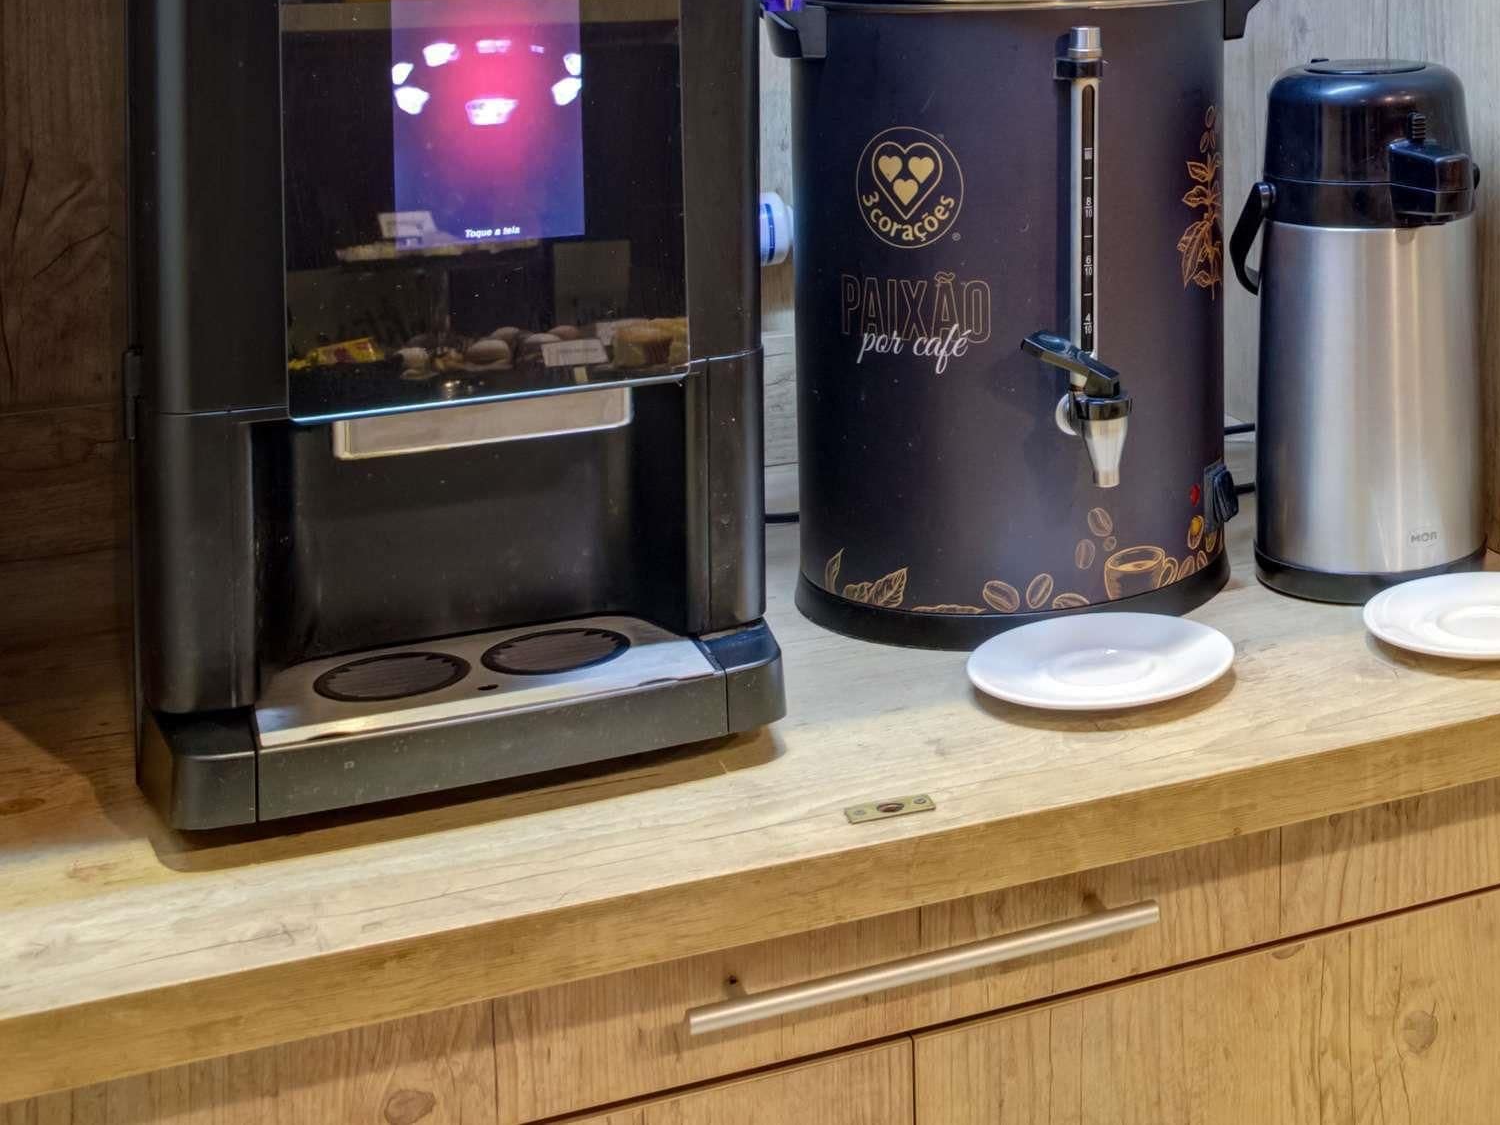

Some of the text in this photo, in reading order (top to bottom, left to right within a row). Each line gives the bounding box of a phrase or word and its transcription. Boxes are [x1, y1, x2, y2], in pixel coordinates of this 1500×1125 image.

[465, 228, 493, 239] Toque
[862, 191, 956, 242] 3 corações
[840, 271, 991, 344] PAIXÃO
[856, 323, 972, 375] por café
